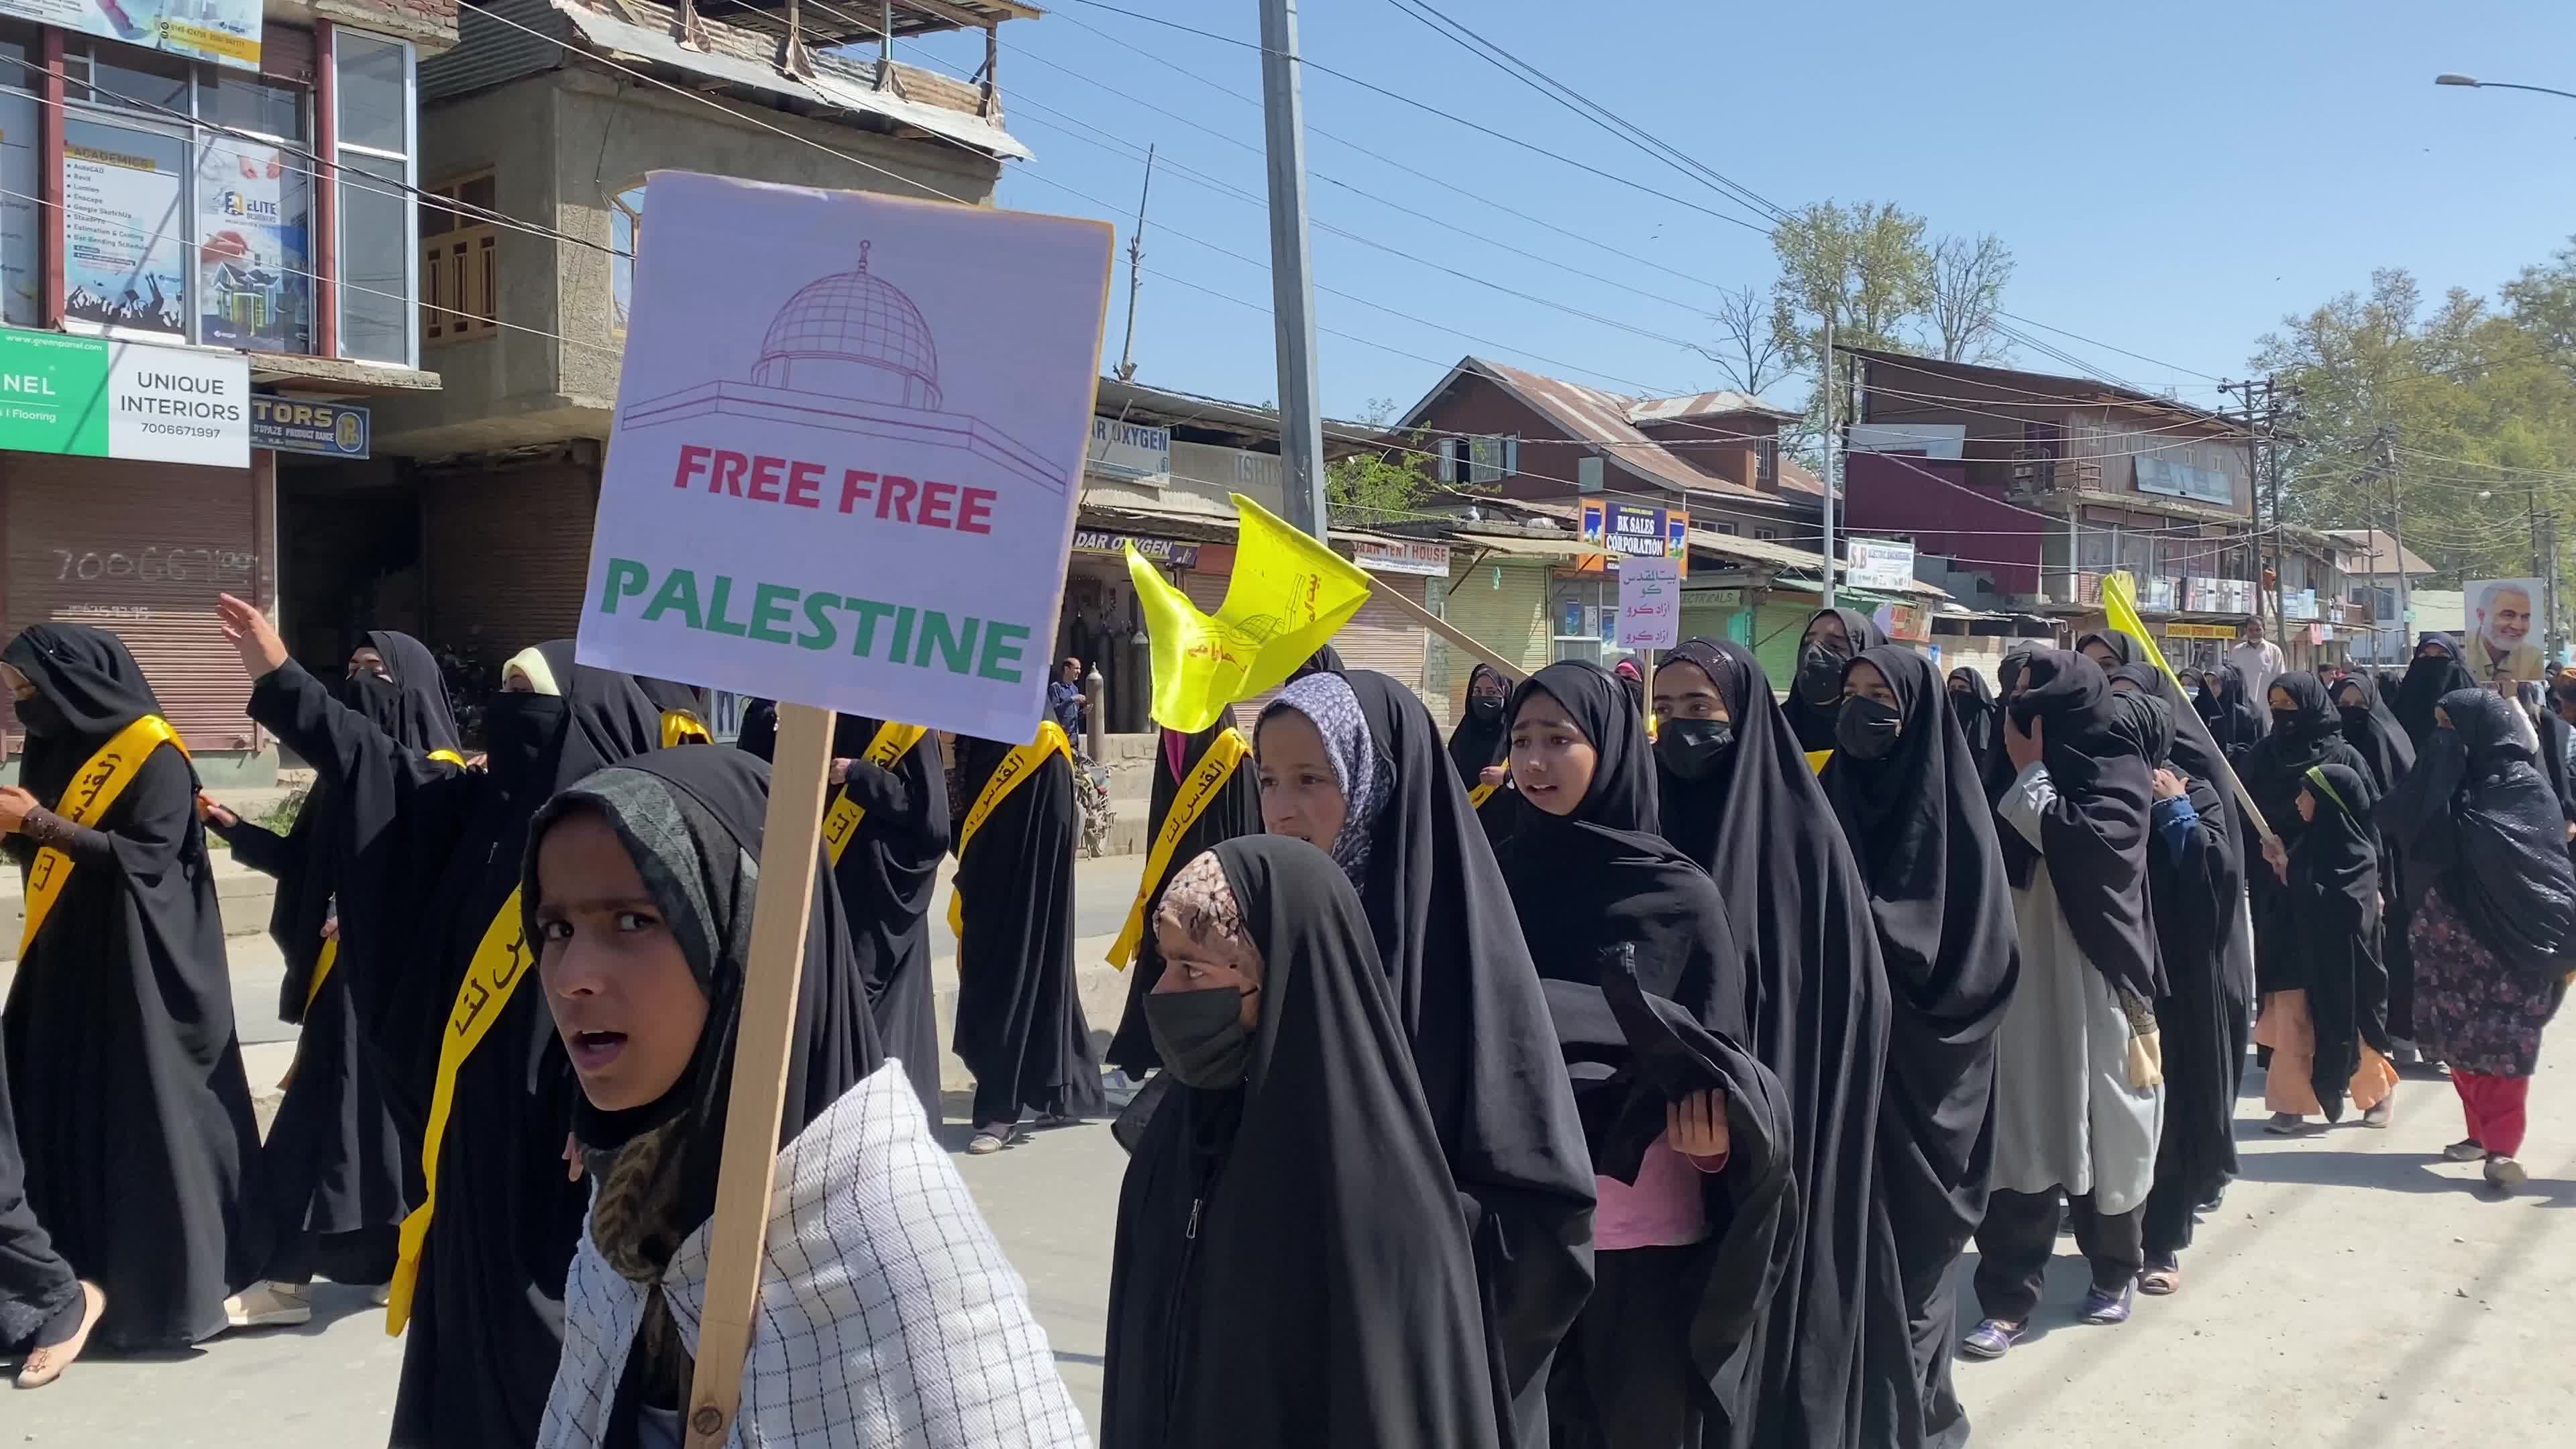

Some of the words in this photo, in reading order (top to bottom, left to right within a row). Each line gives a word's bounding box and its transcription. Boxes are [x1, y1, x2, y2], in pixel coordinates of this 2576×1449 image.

[138, 371, 225, 396] UNIQUE
[12, 409, 56, 423] Flooring
[121, 394, 239, 421] INTERIORS
[252, 402, 333, 428] TORS
[141, 423, 221, 439] 7006671997
[286, 427, 314, 440] PRODUCT
[1112, 421, 1167, 451] OXYGEN
[674, 444, 827, 510] FREE
[838, 469, 998, 535] FREE
[1617, 515, 1630, 532] BK
[1630, 515, 1655, 535] SALES
[1074, 532, 1109, 549] DAR
[1412, 545, 1447, 562] HOUSE
[1606, 534, 1664, 555] CORPORATION
[1682, 592, 1733, 604] ECTRICALS
[600, 557, 1031, 684] PALESTINE
[976, 753, 1025, 822] القدس
[1181, 758, 1226, 824] القدس
[826, 812, 850, 845] لنا
[1166, 817, 1181, 843] لنا
[455, 977, 490, 1037] لنا
